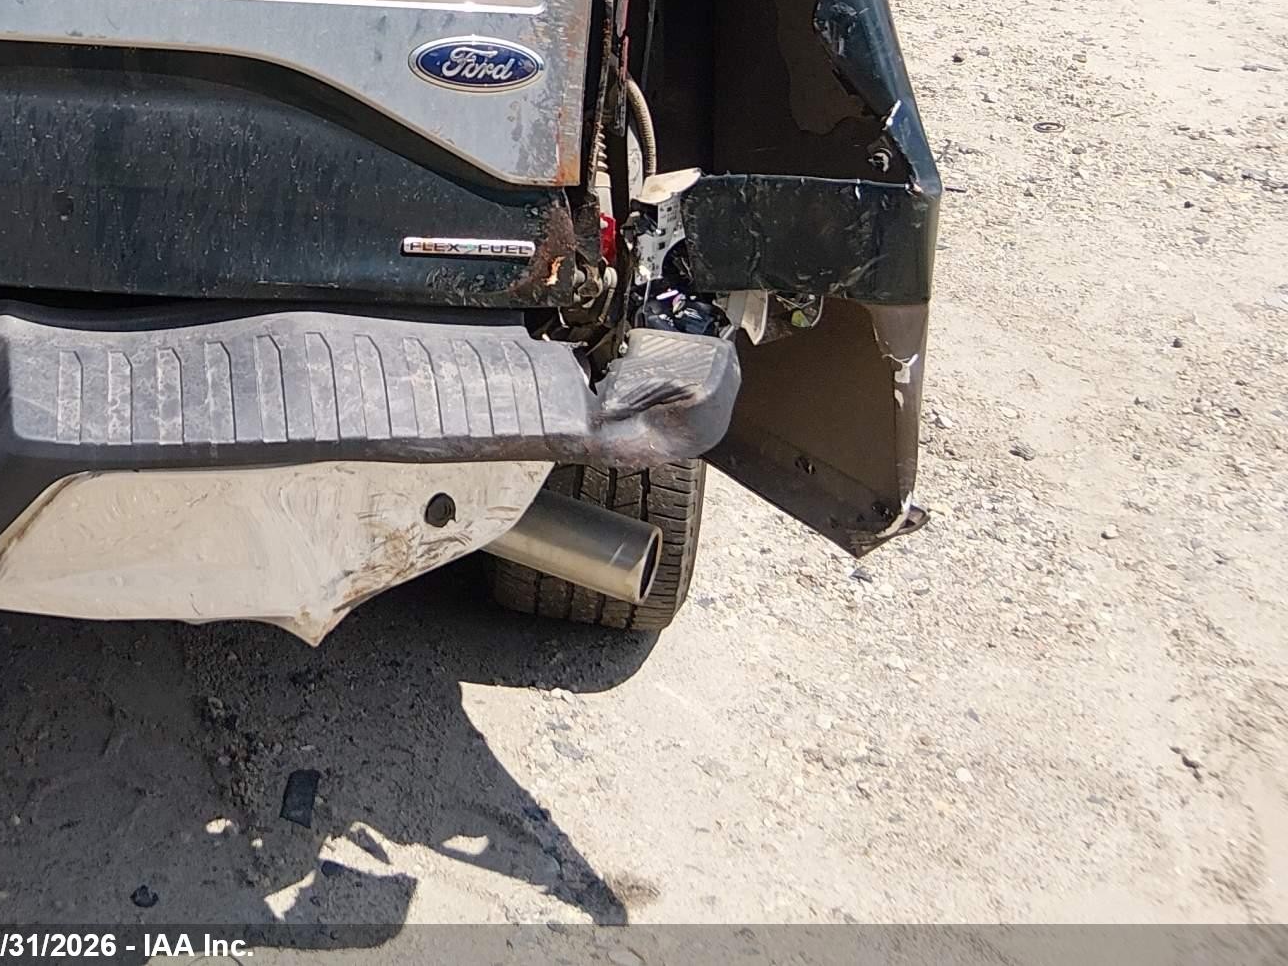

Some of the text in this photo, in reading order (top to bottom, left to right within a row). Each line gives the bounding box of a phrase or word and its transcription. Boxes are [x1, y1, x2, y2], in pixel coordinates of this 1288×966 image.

[441, 46, 515, 81] Ford
[410, 241, 532, 255] FLEX FUEL
